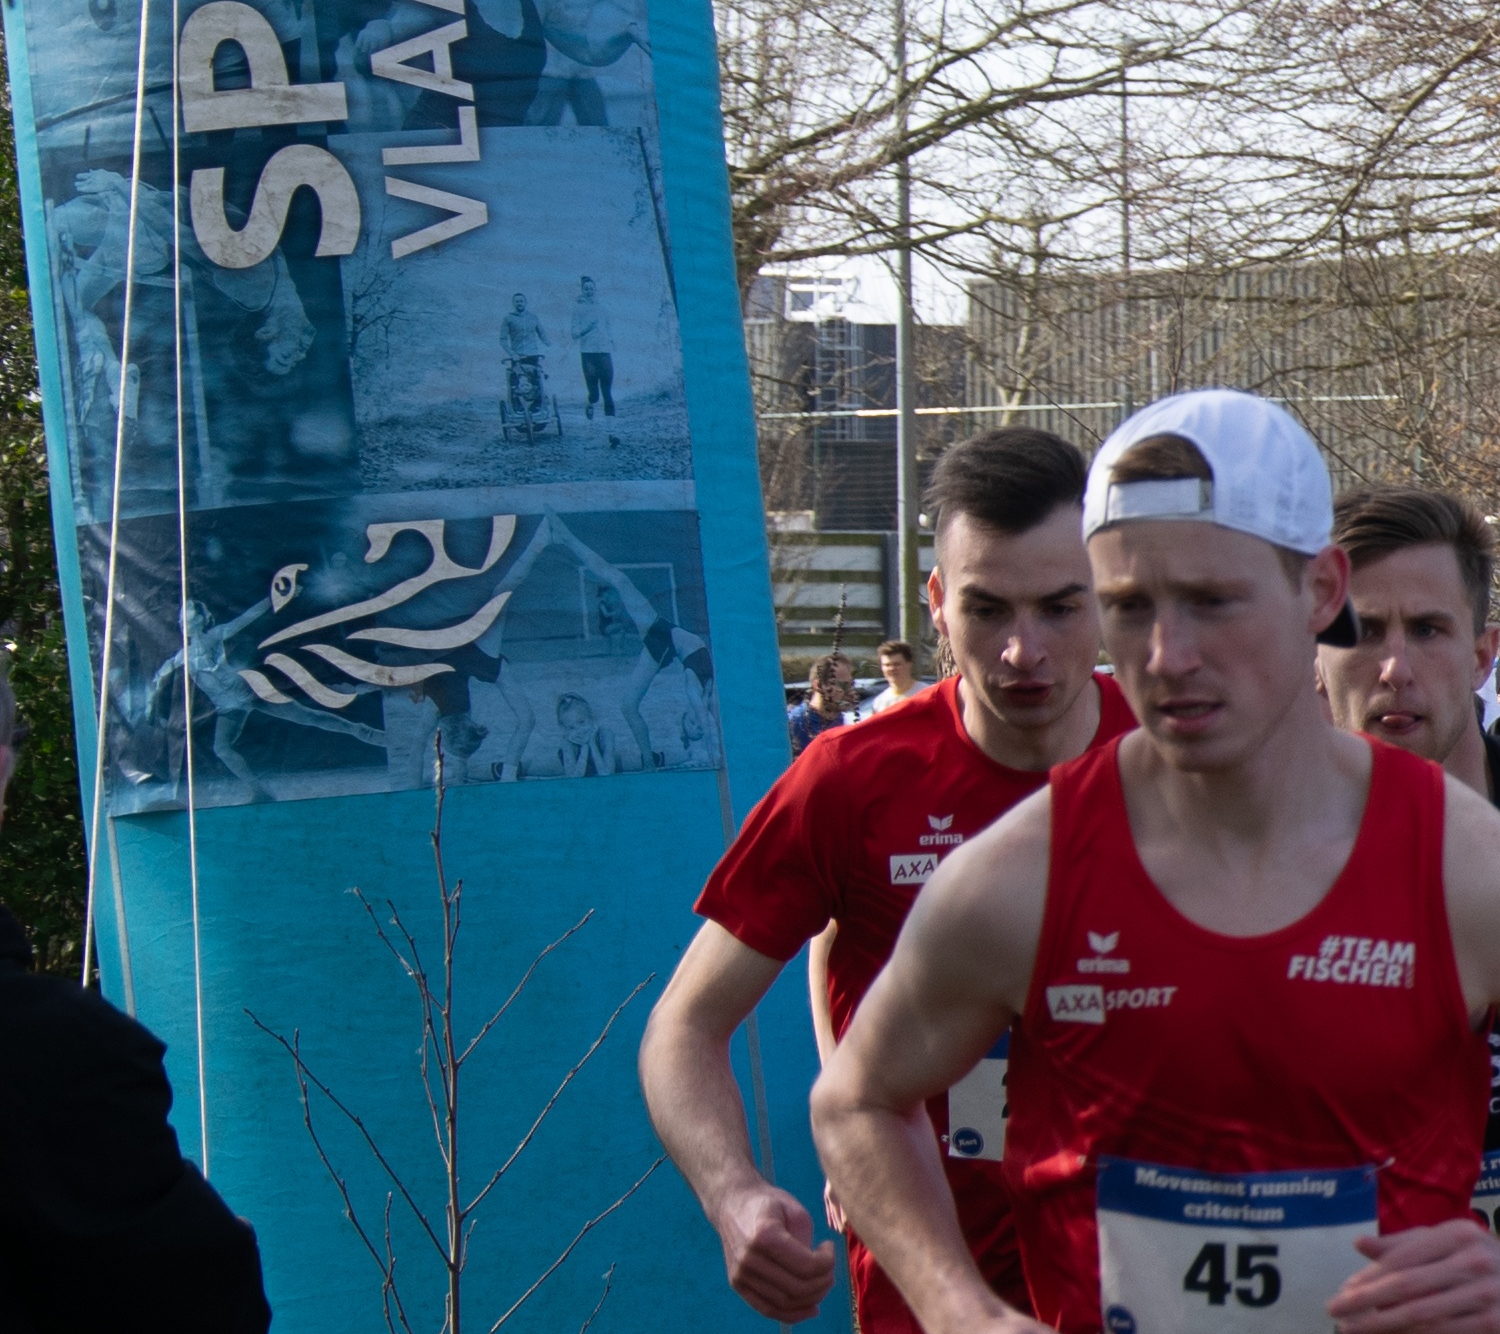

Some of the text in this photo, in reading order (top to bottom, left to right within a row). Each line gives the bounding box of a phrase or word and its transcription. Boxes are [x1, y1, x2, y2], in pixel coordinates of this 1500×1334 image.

[919, 833, 963, 846] erima
[893, 857, 936, 881] AXA
[1319, 935, 1416, 965] #TEAM
[1287, 955, 1404, 988] FISCHER
[1135, 1166, 1337, 1198] Movement running
[1183, 1200, 1285, 1222] criterium
[1183, 1242, 1282, 1308] 45
